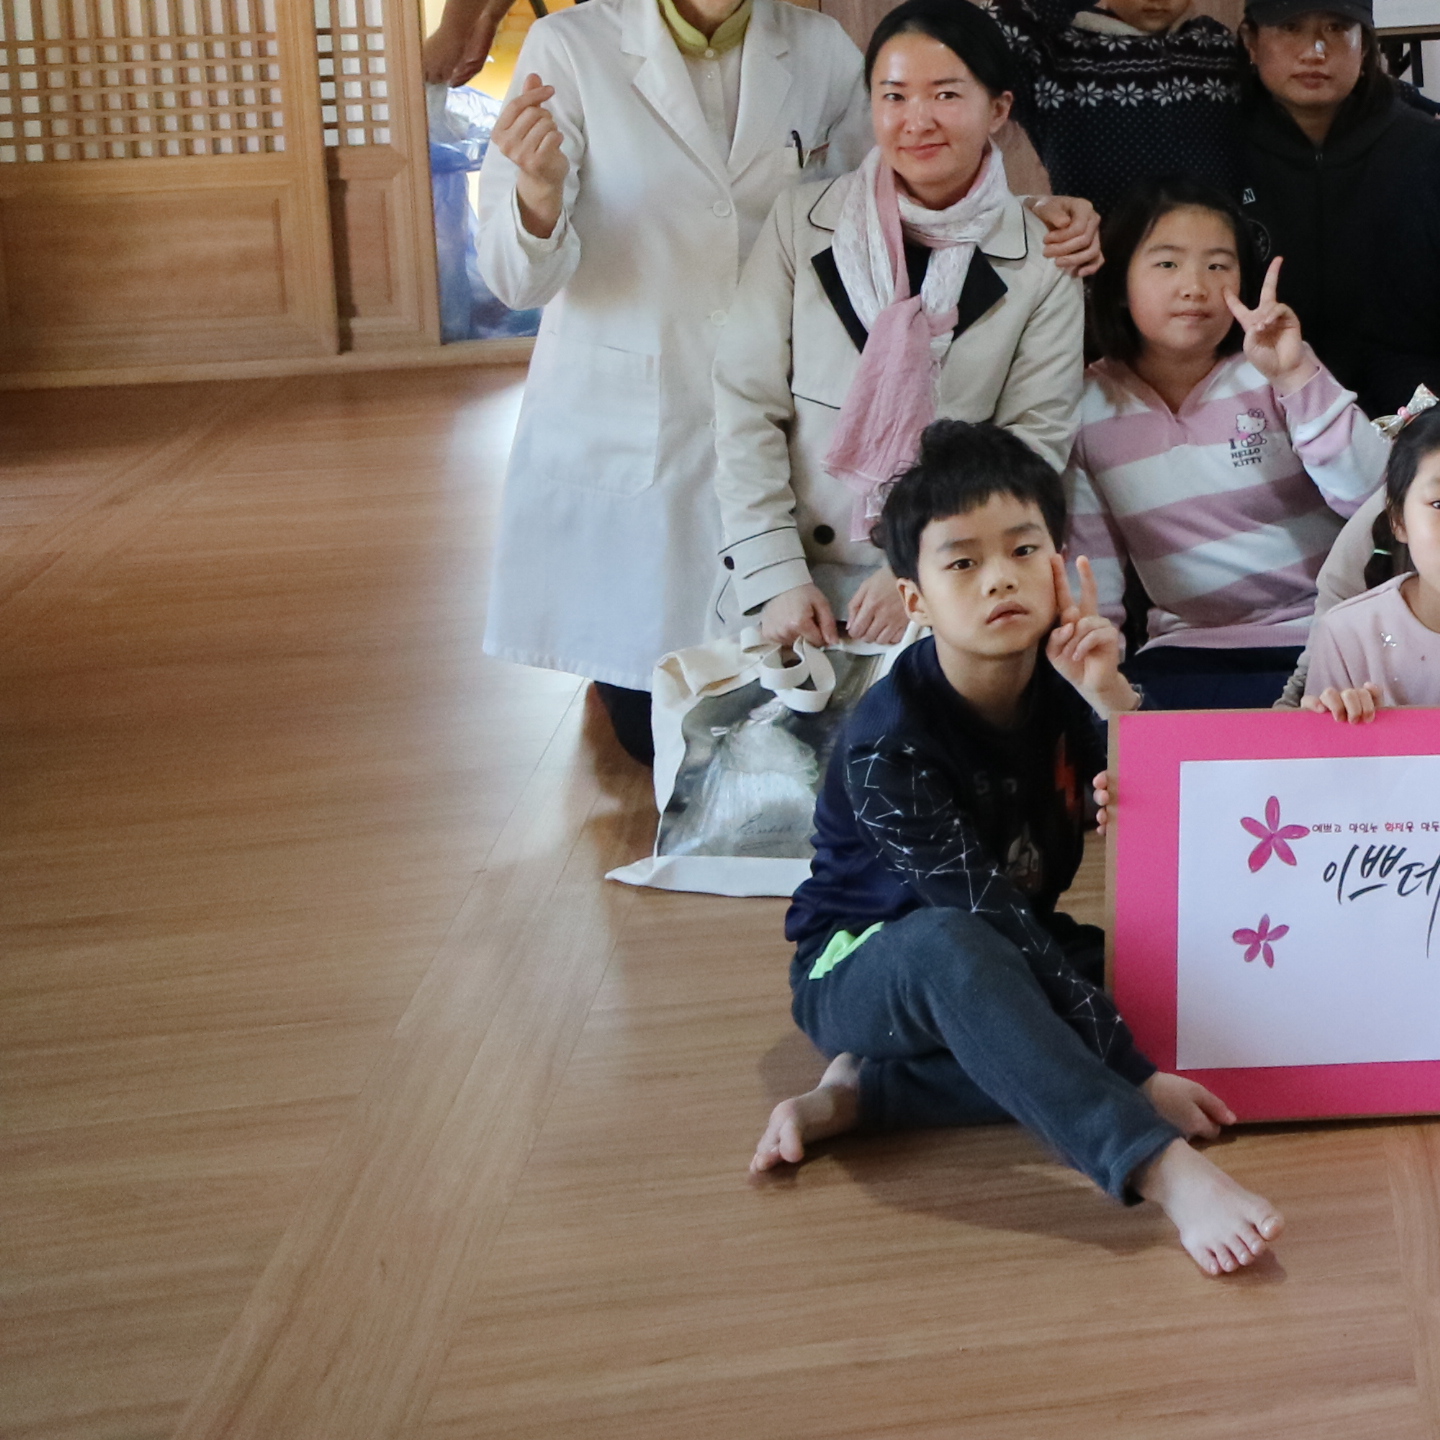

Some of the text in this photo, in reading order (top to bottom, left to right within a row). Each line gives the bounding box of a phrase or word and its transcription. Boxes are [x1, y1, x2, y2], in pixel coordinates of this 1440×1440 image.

[1231, 447, 1261, 459] HELLO
[1233, 456, 1262, 468] KITTY
[1312, 823, 1342, 833] 예쁘고
